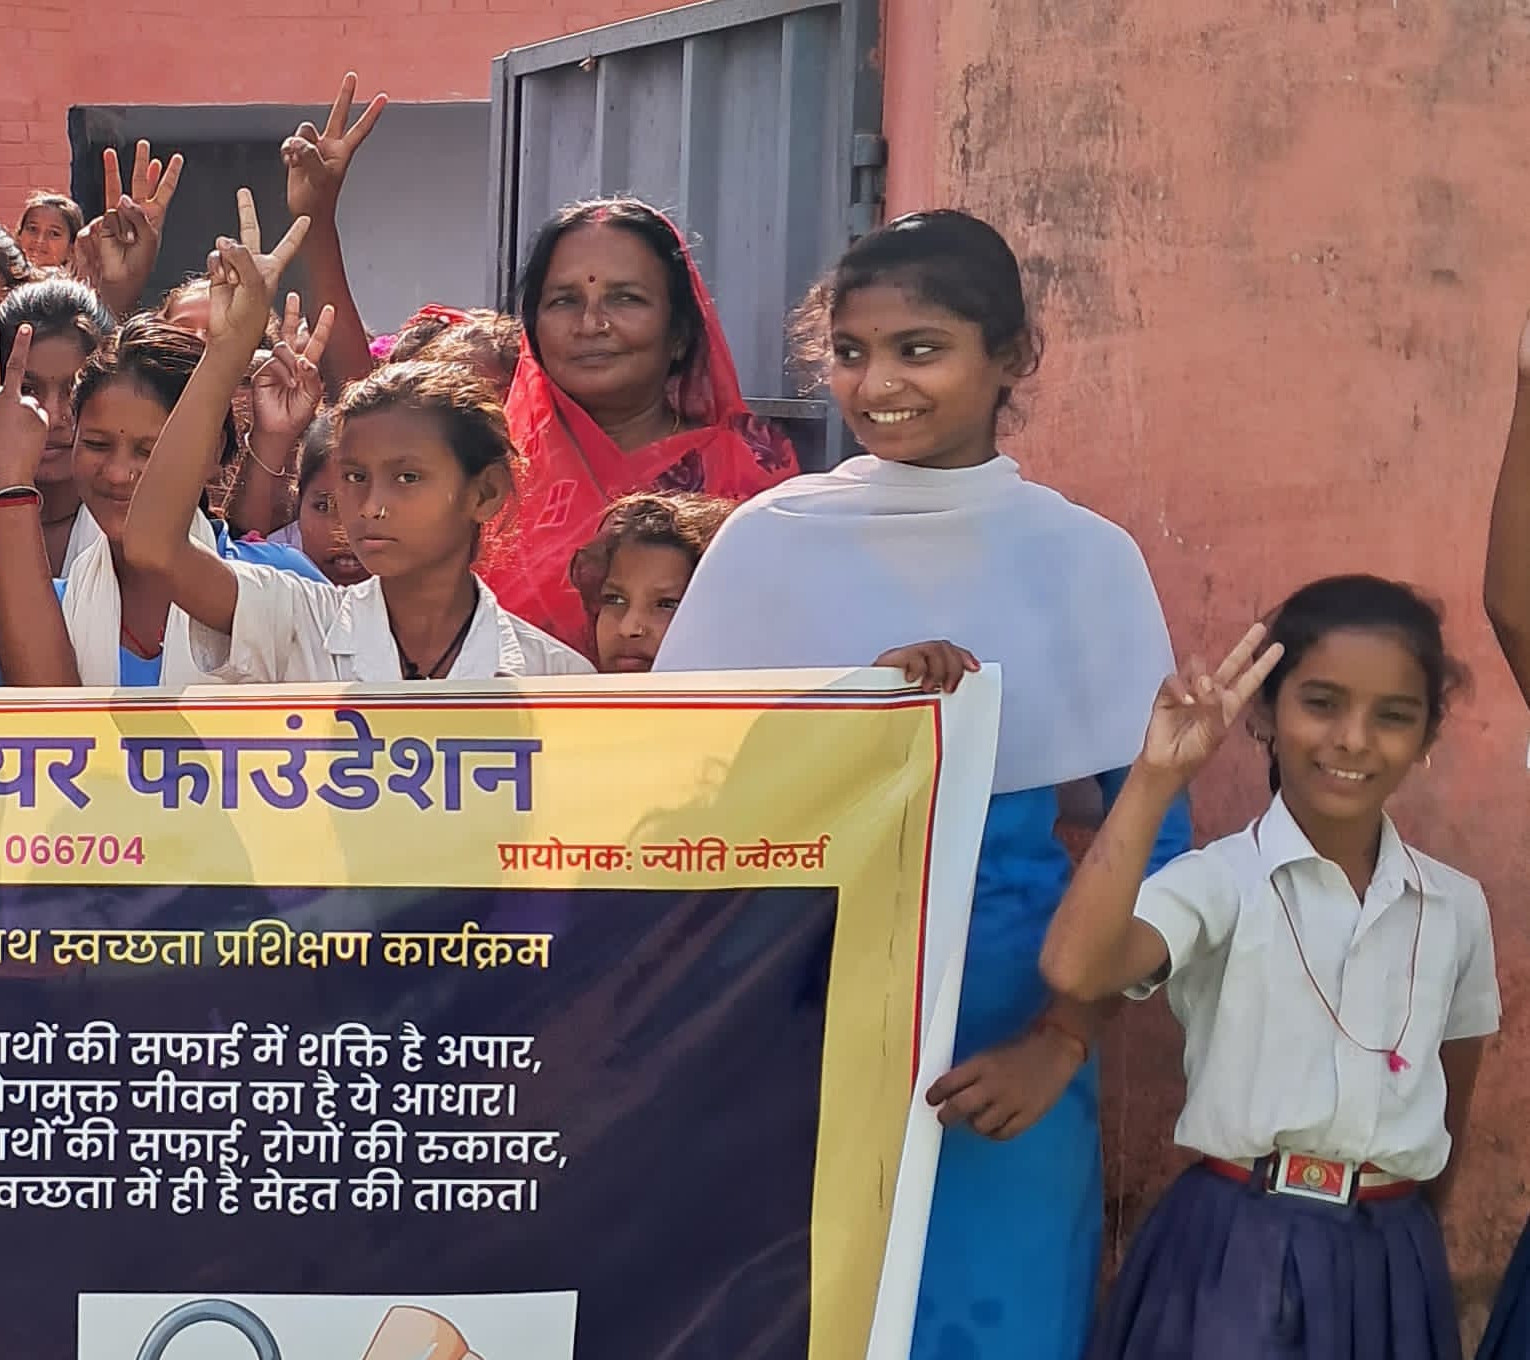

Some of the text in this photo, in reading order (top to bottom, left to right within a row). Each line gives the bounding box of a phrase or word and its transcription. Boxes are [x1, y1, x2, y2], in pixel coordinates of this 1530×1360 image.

[122, 711, 544, 813] फाउंडेशन
[4, 835, 145, 865] 066704
[640, 838, 728, 872] ज्योति
[734, 834, 830, 870] ज्वेलर्स
[51, 930, 204, 966] स्वच्छता
[214, 919, 371, 969] प्रशिक्षण
[381, 922, 553, 969] कार्यक्रम
[64, 1021, 121, 1065] की
[128, 1022, 248, 1069] सफाई
[251, 1024, 290, 1066] में
[297, 1022, 392, 1068] शक्ति
[399, 1021, 426, 1072] है
[436, 1035, 543, 1074] अपार,
[129, 1070, 242, 1114] जीवन
[249, 1081, 305, 1115] का
[312, 1070, 340, 1120] है
[347, 1073, 381, 1117] ये
[63, 1117, 119, 1162] की
[126, 1119, 249, 1169] सफाई,
[260, 1121, 347, 1164] रोगों
[351, 1119, 407, 1165] की
[124, 1167, 163, 1210] में
[168, 1166, 208, 1214] ही
[216, 1165, 242, 1214] है
[250, 1168, 341, 1215] सेहत
[349, 1167, 405, 1211] की
